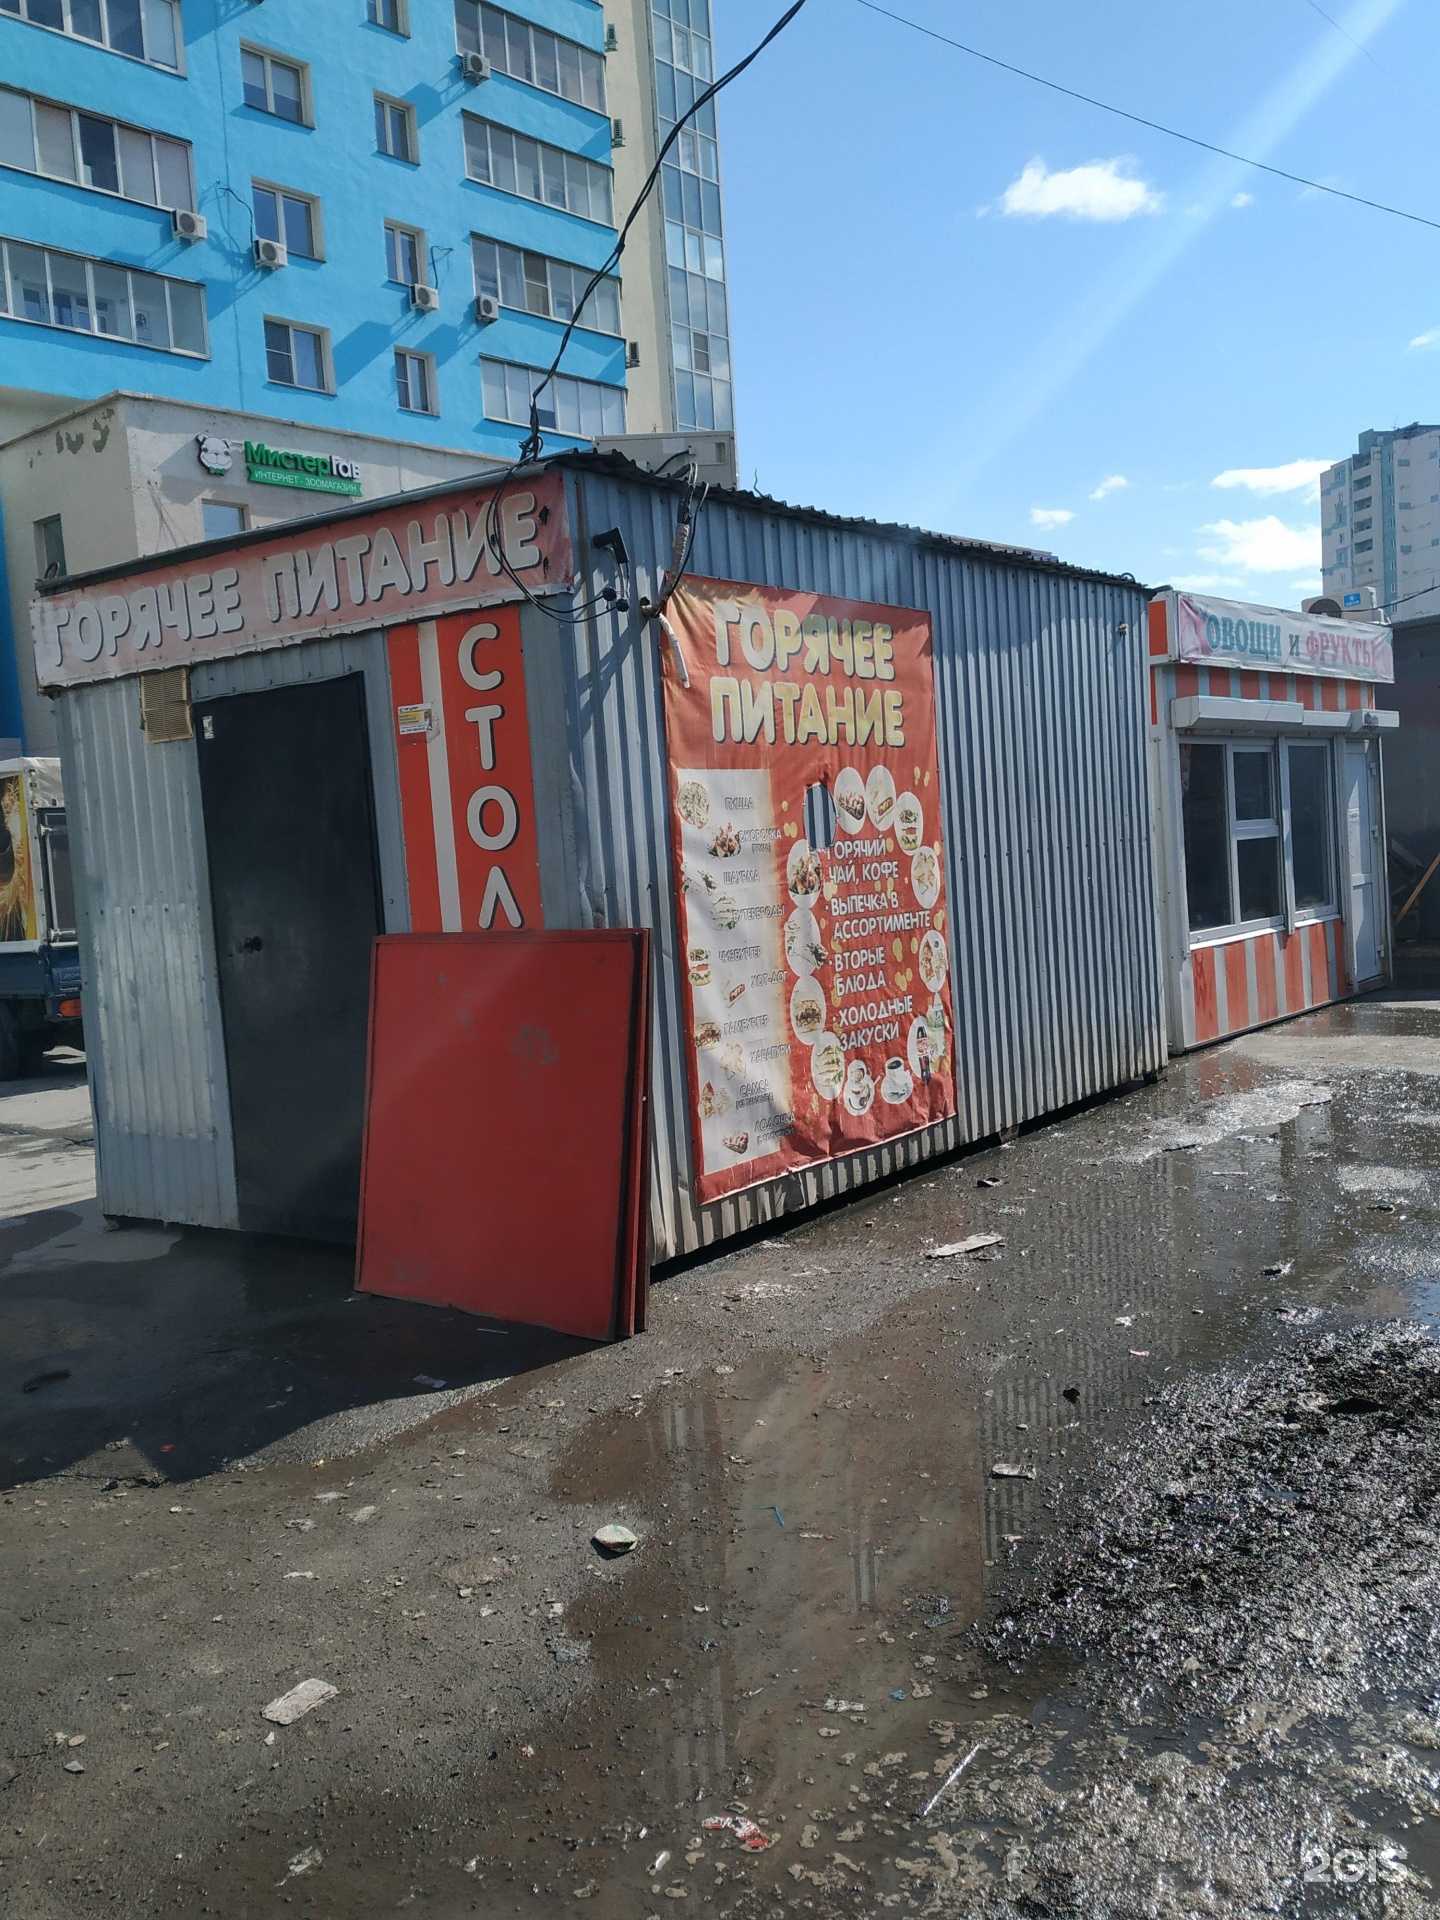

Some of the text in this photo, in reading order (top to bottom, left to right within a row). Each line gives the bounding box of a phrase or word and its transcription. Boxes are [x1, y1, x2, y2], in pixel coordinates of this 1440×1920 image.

[54, 492, 543, 667] ГОРЯЧЕЕ ПИТАНИЕ
[712, 602, 896, 681] ГОРЯЧЕЕ
[1206, 615, 1281, 662] ОВОЩИ
[1305, 631, 1378, 667] ФРУКТЫ
[710, 676, 905, 747] ПИТАНИЕ
[828, 860, 899, 886] ЧАЙ, КОФЕ
[831, 891, 899, 916] ВЫПЕЧКА В
[834, 910, 931, 942] АССОРТИМЕНТЕ
[834, 946, 886, 972] ВТОРЫЕ
[836, 970, 886, 998] БЛЮДА
[838, 995, 913, 1027] ХОЛОДНЫЕ
[840, 1022, 899, 1052] ЗАКУСКИ
